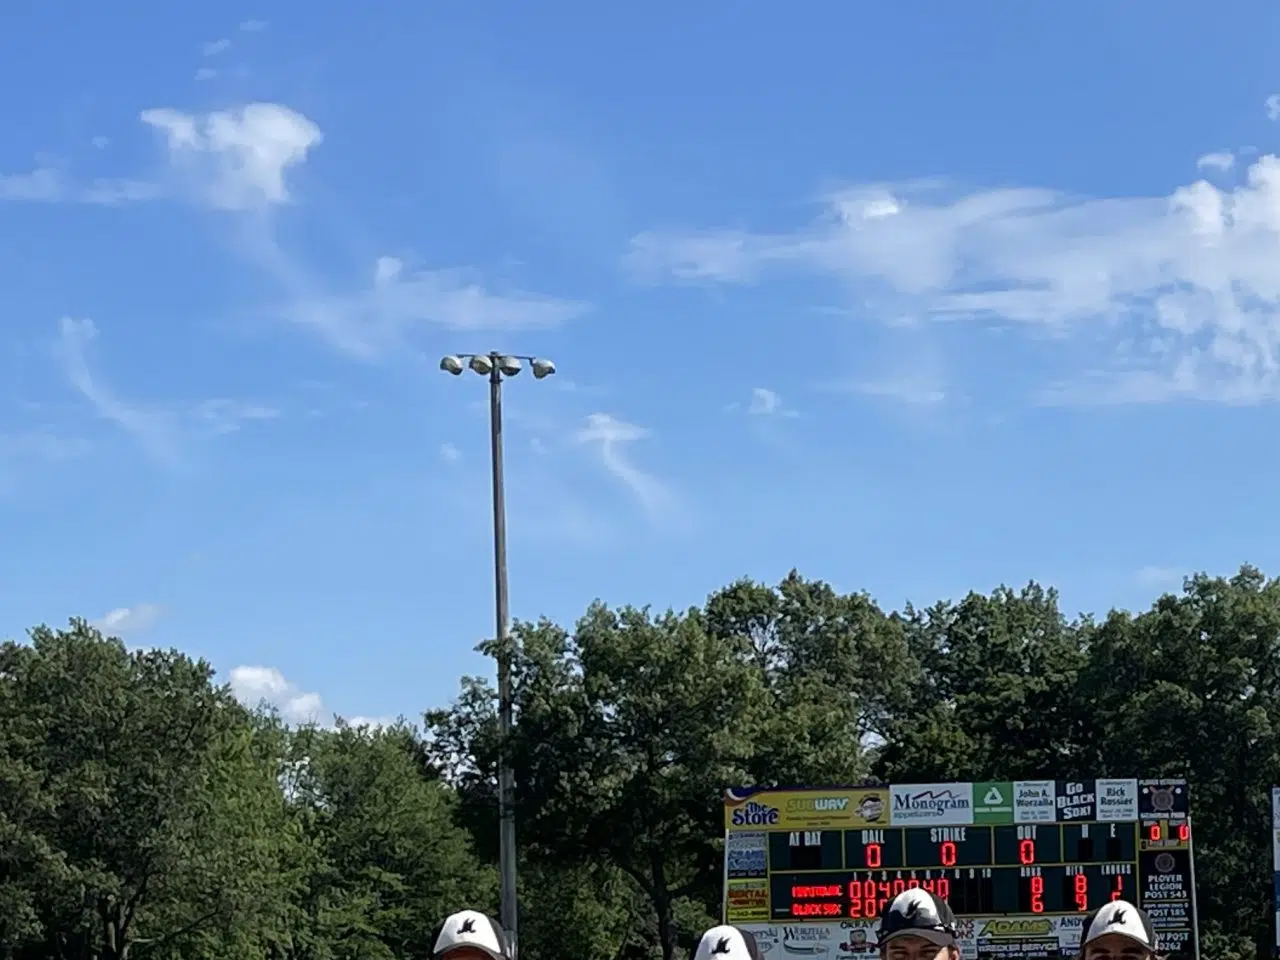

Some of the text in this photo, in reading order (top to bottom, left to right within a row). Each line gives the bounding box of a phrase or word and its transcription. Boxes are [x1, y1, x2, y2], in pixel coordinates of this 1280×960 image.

[1019, 789, 1038, 799] John
[1106, 787, 1126, 796] Rick
[785, 797, 848, 812] SUBWAY
[894, 793, 970, 816] Monogram
[732, 807, 779, 825] Store
[861, 829, 885, 845] BALL
[930, 827, 966, 843] STRIKE
[1016, 825, 1037, 841] OUT
[1110, 823, 1116, 837] E
[1151, 825, 1161, 841] 0
[789, 831, 821, 846] AT BAT
[866, 843, 881, 869] 0
[941, 842, 956, 867] 0
[1019, 839, 1034, 866] 0
[1075, 874, 1087, 893] 8
[1148, 874, 1183, 882] PLOVER
[1150, 882, 1182, 890] LEGION
[1144, 891, 1168, 899] POST
[850, 898, 862, 919] 2
[976, 919, 1053, 937] ADAMS
[1023, 944, 1059, 952] SERVICE
